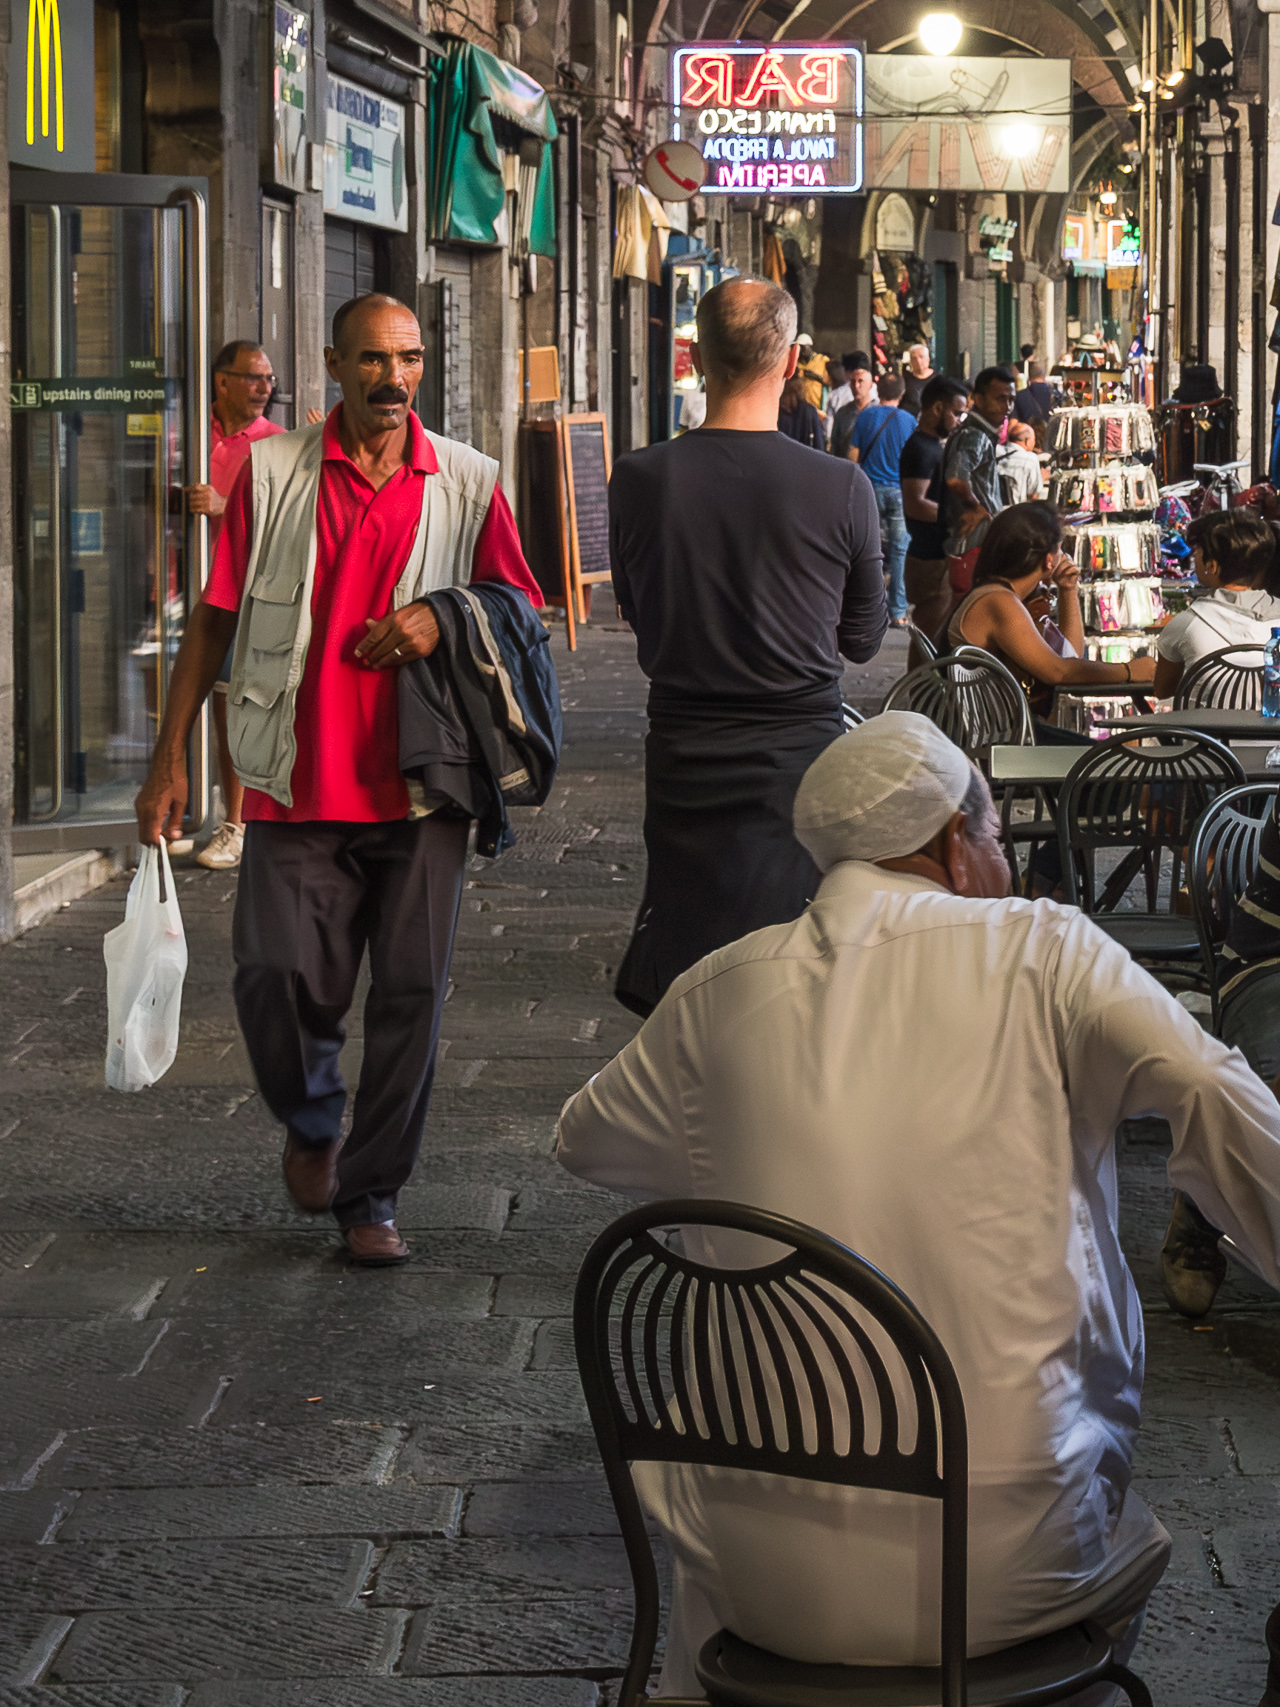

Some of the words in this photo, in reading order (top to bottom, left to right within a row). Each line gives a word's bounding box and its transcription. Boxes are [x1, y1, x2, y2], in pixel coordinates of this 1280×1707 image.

[43, 387, 92, 403] upstairs
[93, 386, 131, 403] dining
[133, 388, 165, 401] room
